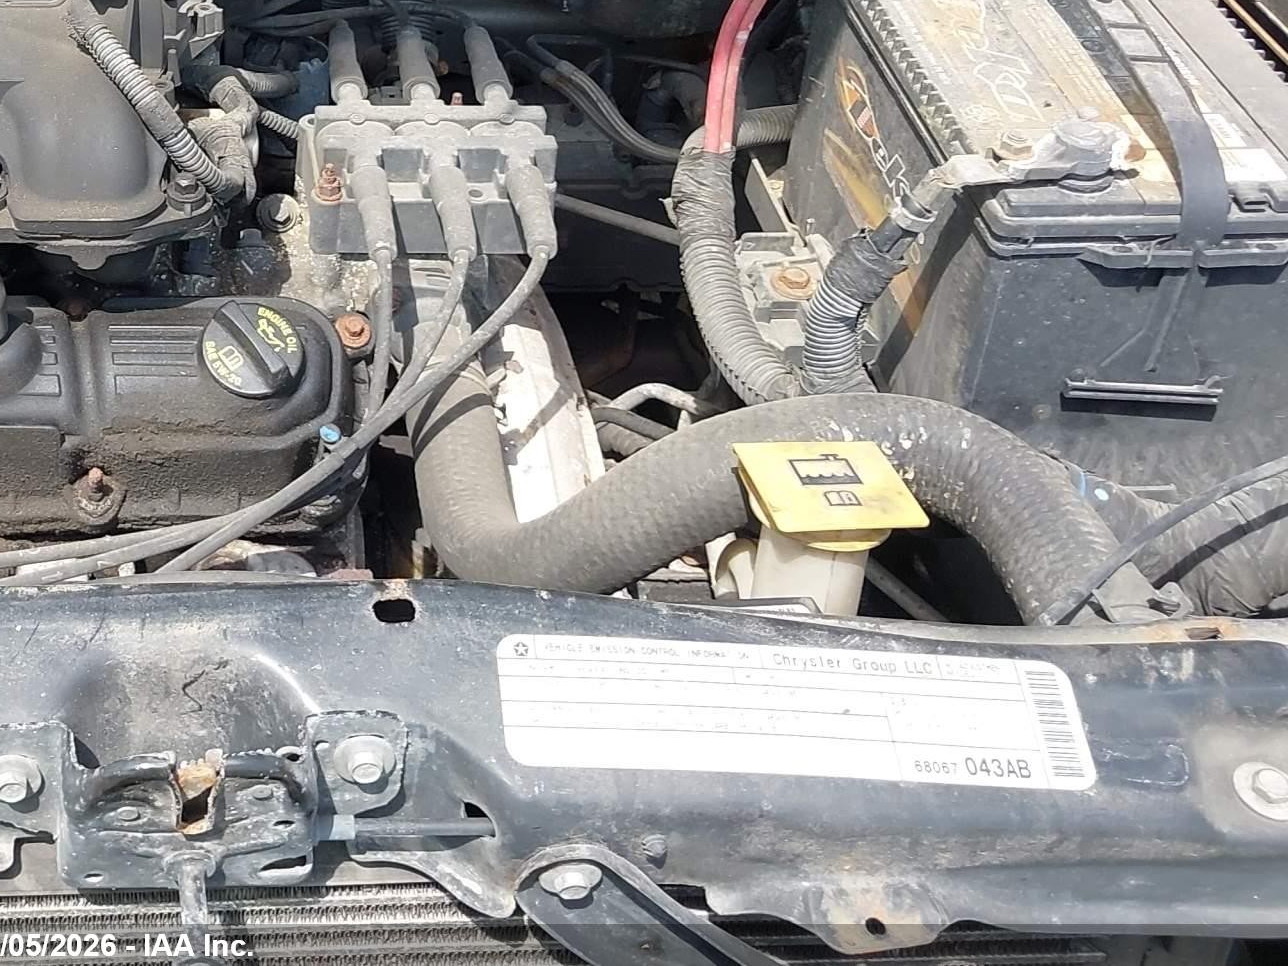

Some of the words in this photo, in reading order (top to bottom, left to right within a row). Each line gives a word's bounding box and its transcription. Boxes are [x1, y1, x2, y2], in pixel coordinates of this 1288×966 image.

[256, 306, 295, 337] ENGINE
[286, 336, 298, 354] OIL
[641, 647, 680, 658] CONTROL
[772, 653, 843, 672] Chrysler
[852, 658, 898, 677] Group
[904, 661, 934, 675] LLC
[914, 759, 959, 776] 68067
[964, 756, 1033, 781] 043AB
